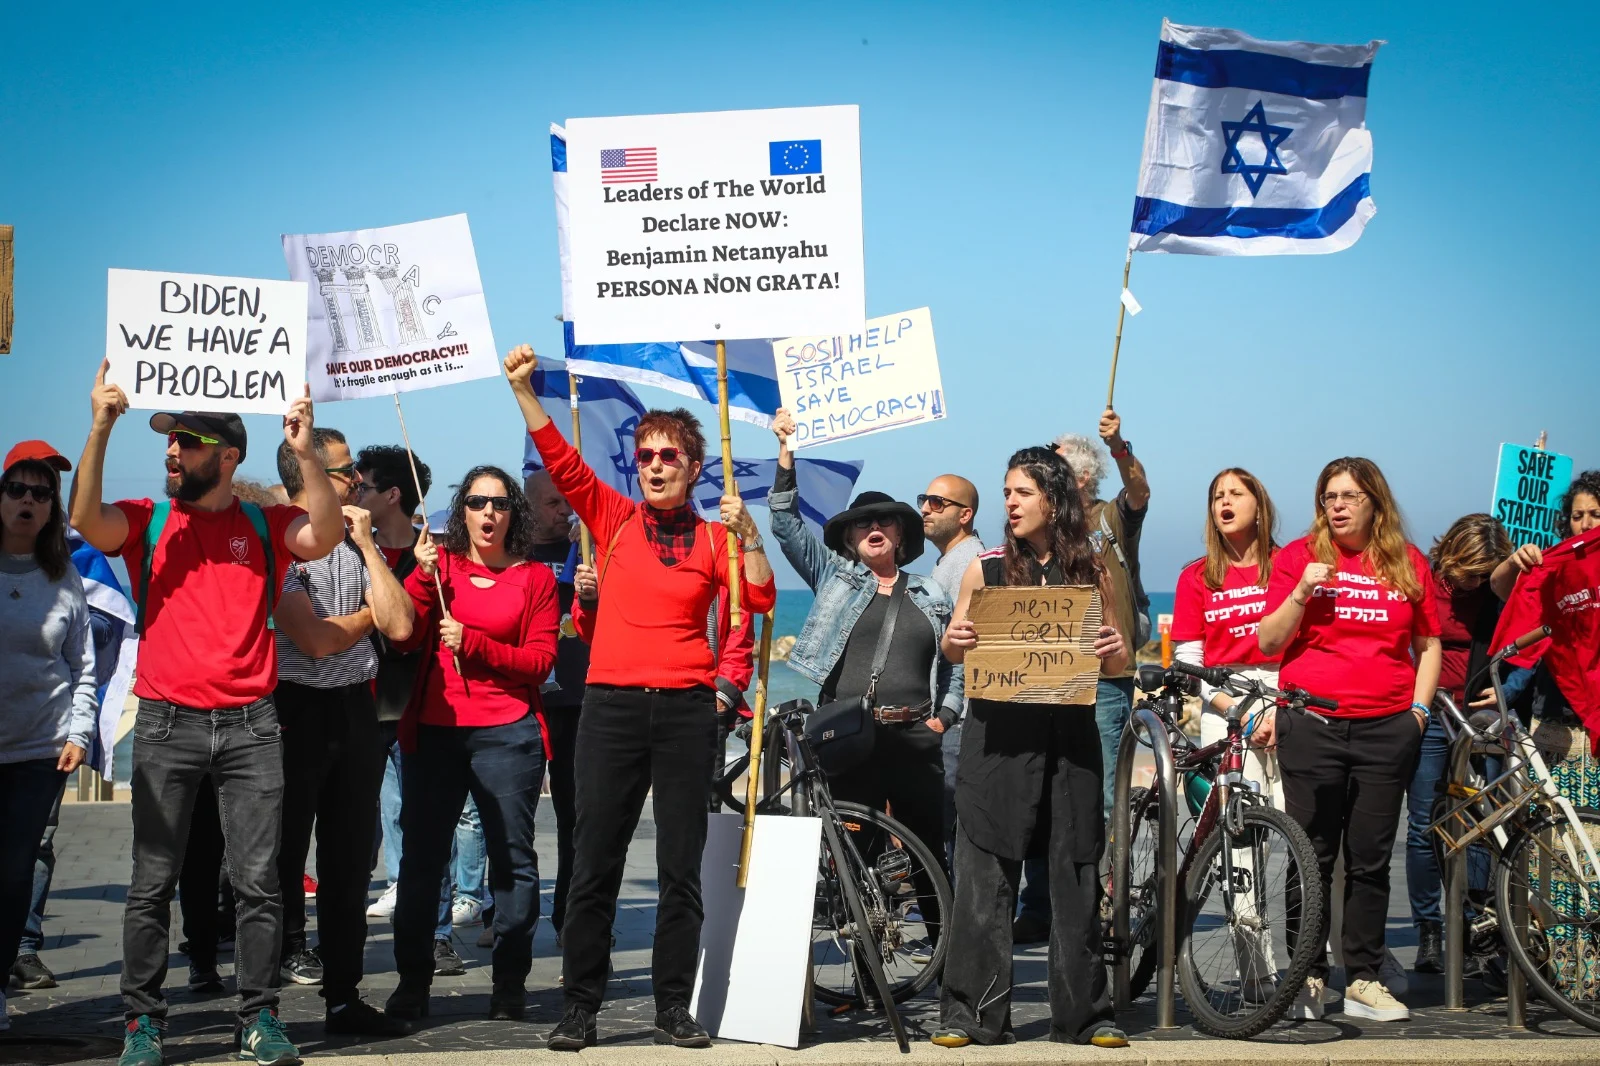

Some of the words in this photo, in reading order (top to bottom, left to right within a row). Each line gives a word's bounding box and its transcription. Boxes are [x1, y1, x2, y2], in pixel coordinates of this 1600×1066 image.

[603, 181, 683, 204] Leaders
[688, 180, 709, 200] of
[713, 179, 755, 198] The
[759, 175, 826, 197] World
[642, 213, 720, 233] Declare
[725, 211, 788, 229] NOW:
[607, 246, 707, 270] Benjamin
[712, 240, 828, 267] Netanyahu
[597, 276, 698, 298] PERSONA
[703, 275, 751, 294] NON
[757, 271, 840, 292] GRATA!
[161, 280, 267, 324] BIDEN,
[120, 323, 173, 351] WE
[188, 326, 263, 355] HAVE
[269, 326, 290, 355] A
[849, 318, 912, 352] HELP
[326, 360, 348, 375] SAVE
[349, 357, 372, 373] OUR
[375, 343, 469, 370] DEMOCRACY!!!
[794, 354, 894, 390] ISRAEL
[135, 361, 286, 401] PROBLEM
[334, 377, 345, 388] It's
[348, 374, 375, 387] fragile
[378, 368, 417, 383] enough
[419, 367, 431, 375] as
[434, 363, 442, 373] it
[445, 362, 463, 372] is...
[796, 387, 851, 413] SAVE
[1518, 449, 1556, 480] SAVE
[1517, 476, 1549, 506] OUR
[1008, 598, 1074, 618] דורשות
[1334, 606, 1388, 622] בקלפי
[1010, 620, 1074, 644] משפט
[1023, 650, 1074, 672] חוקתי
